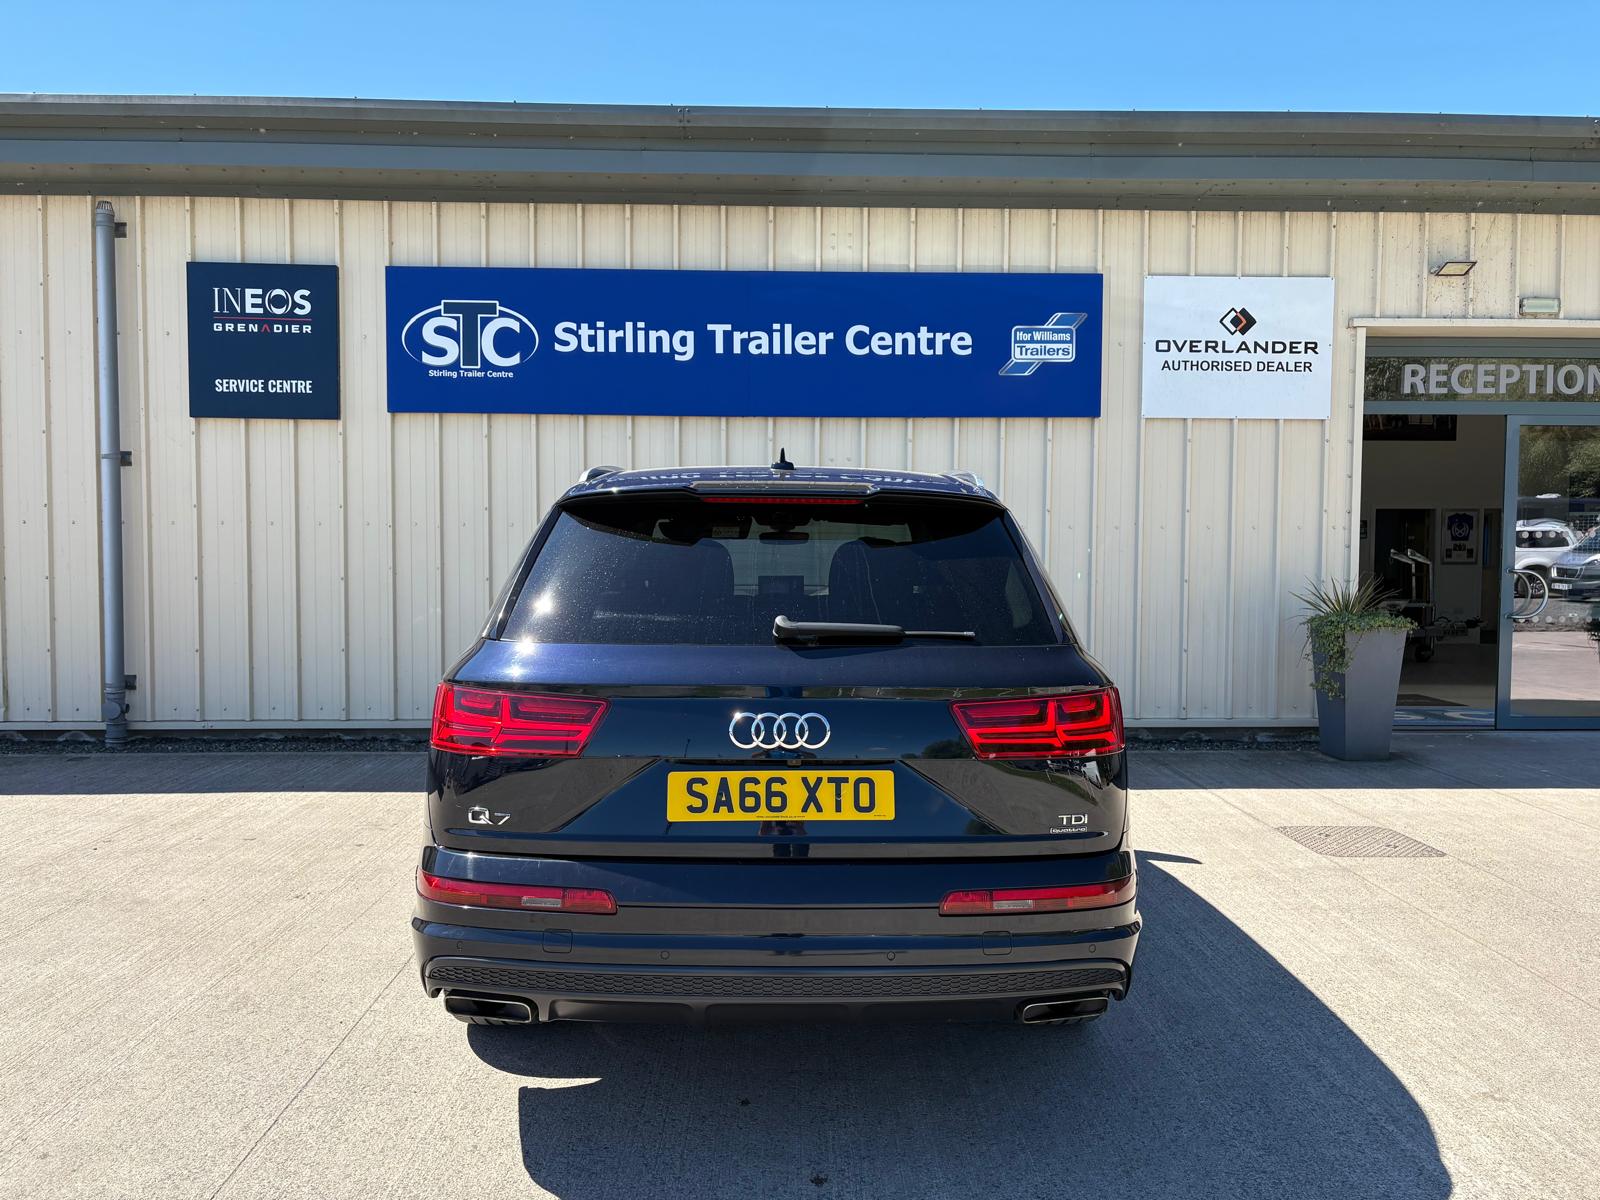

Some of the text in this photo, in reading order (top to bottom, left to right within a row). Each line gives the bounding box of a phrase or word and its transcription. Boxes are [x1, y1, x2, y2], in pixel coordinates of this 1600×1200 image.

[212, 287, 312, 316] INEOS
[213, 322, 312, 335] GRENADIER
[421, 299, 521, 369] STC
[1016, 330, 1071, 342] Ifor Williams
[553, 320, 973, 361] Stirling Trailer Centre
[1155, 339, 1319, 355] OVERLANDER
[1016, 343, 1070, 357] Trailers
[428, 368, 514, 379] Stirling Trailer Centre
[1161, 359, 1313, 374] AUTHORISED DEALER
[214, 378, 313, 395] SERVICE CENTRE
[686, 776, 876, 814] SA66 XTO
[468, 806, 511, 825] Q7
[1058, 813, 1088, 825] TDI
